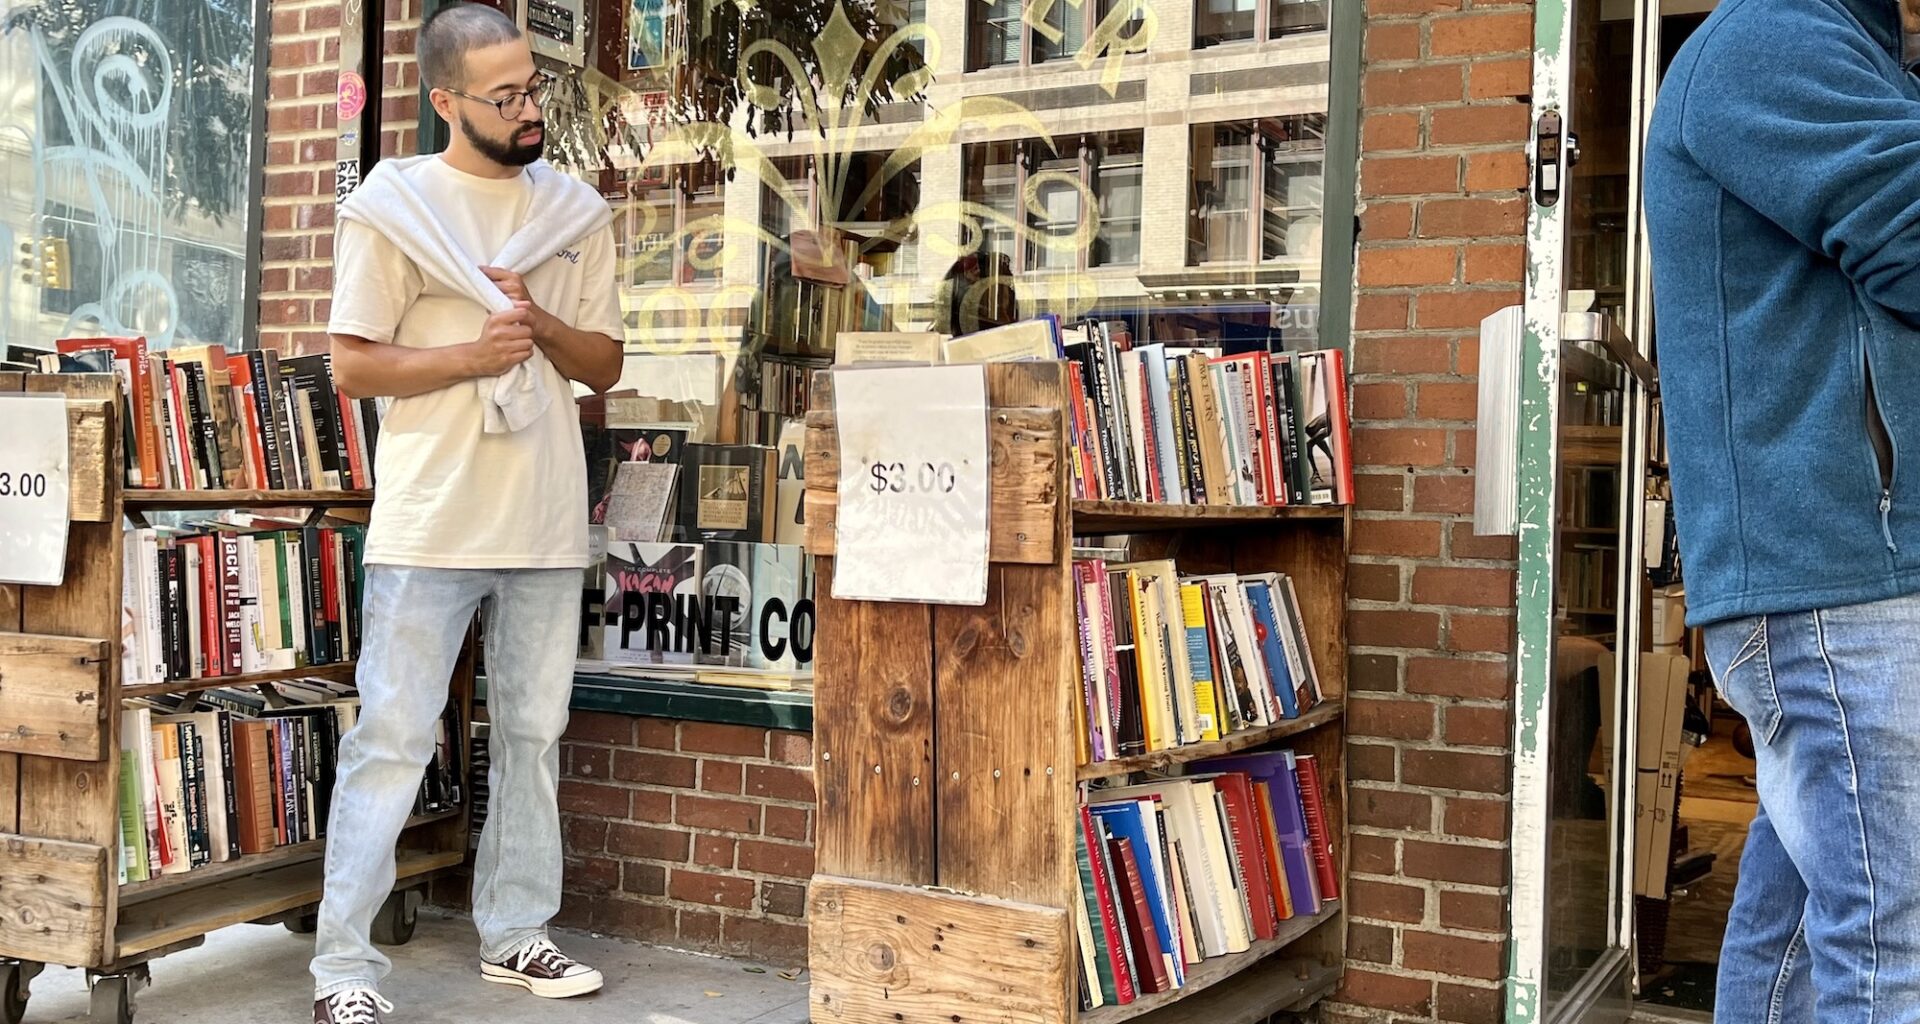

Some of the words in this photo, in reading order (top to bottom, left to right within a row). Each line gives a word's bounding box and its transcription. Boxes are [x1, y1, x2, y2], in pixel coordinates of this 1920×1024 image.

[137, 344, 146, 374] LUPICA
[1101, 428, 1111, 464] Thomas
[1287, 407, 1298, 459] TWISTER
[870, 461, 955, 494] $3.00
[618, 571, 675, 593] KAGAN
[1084, 617, 1097, 681] UNWAVERING
[185, 725, 194, 754] SAMMY
[187, 755, 195, 778] CAHN
[189, 786, 197, 812] Should
[1107, 903, 1117, 934] LOVE
[1115, 946, 1126, 974] RUIN
